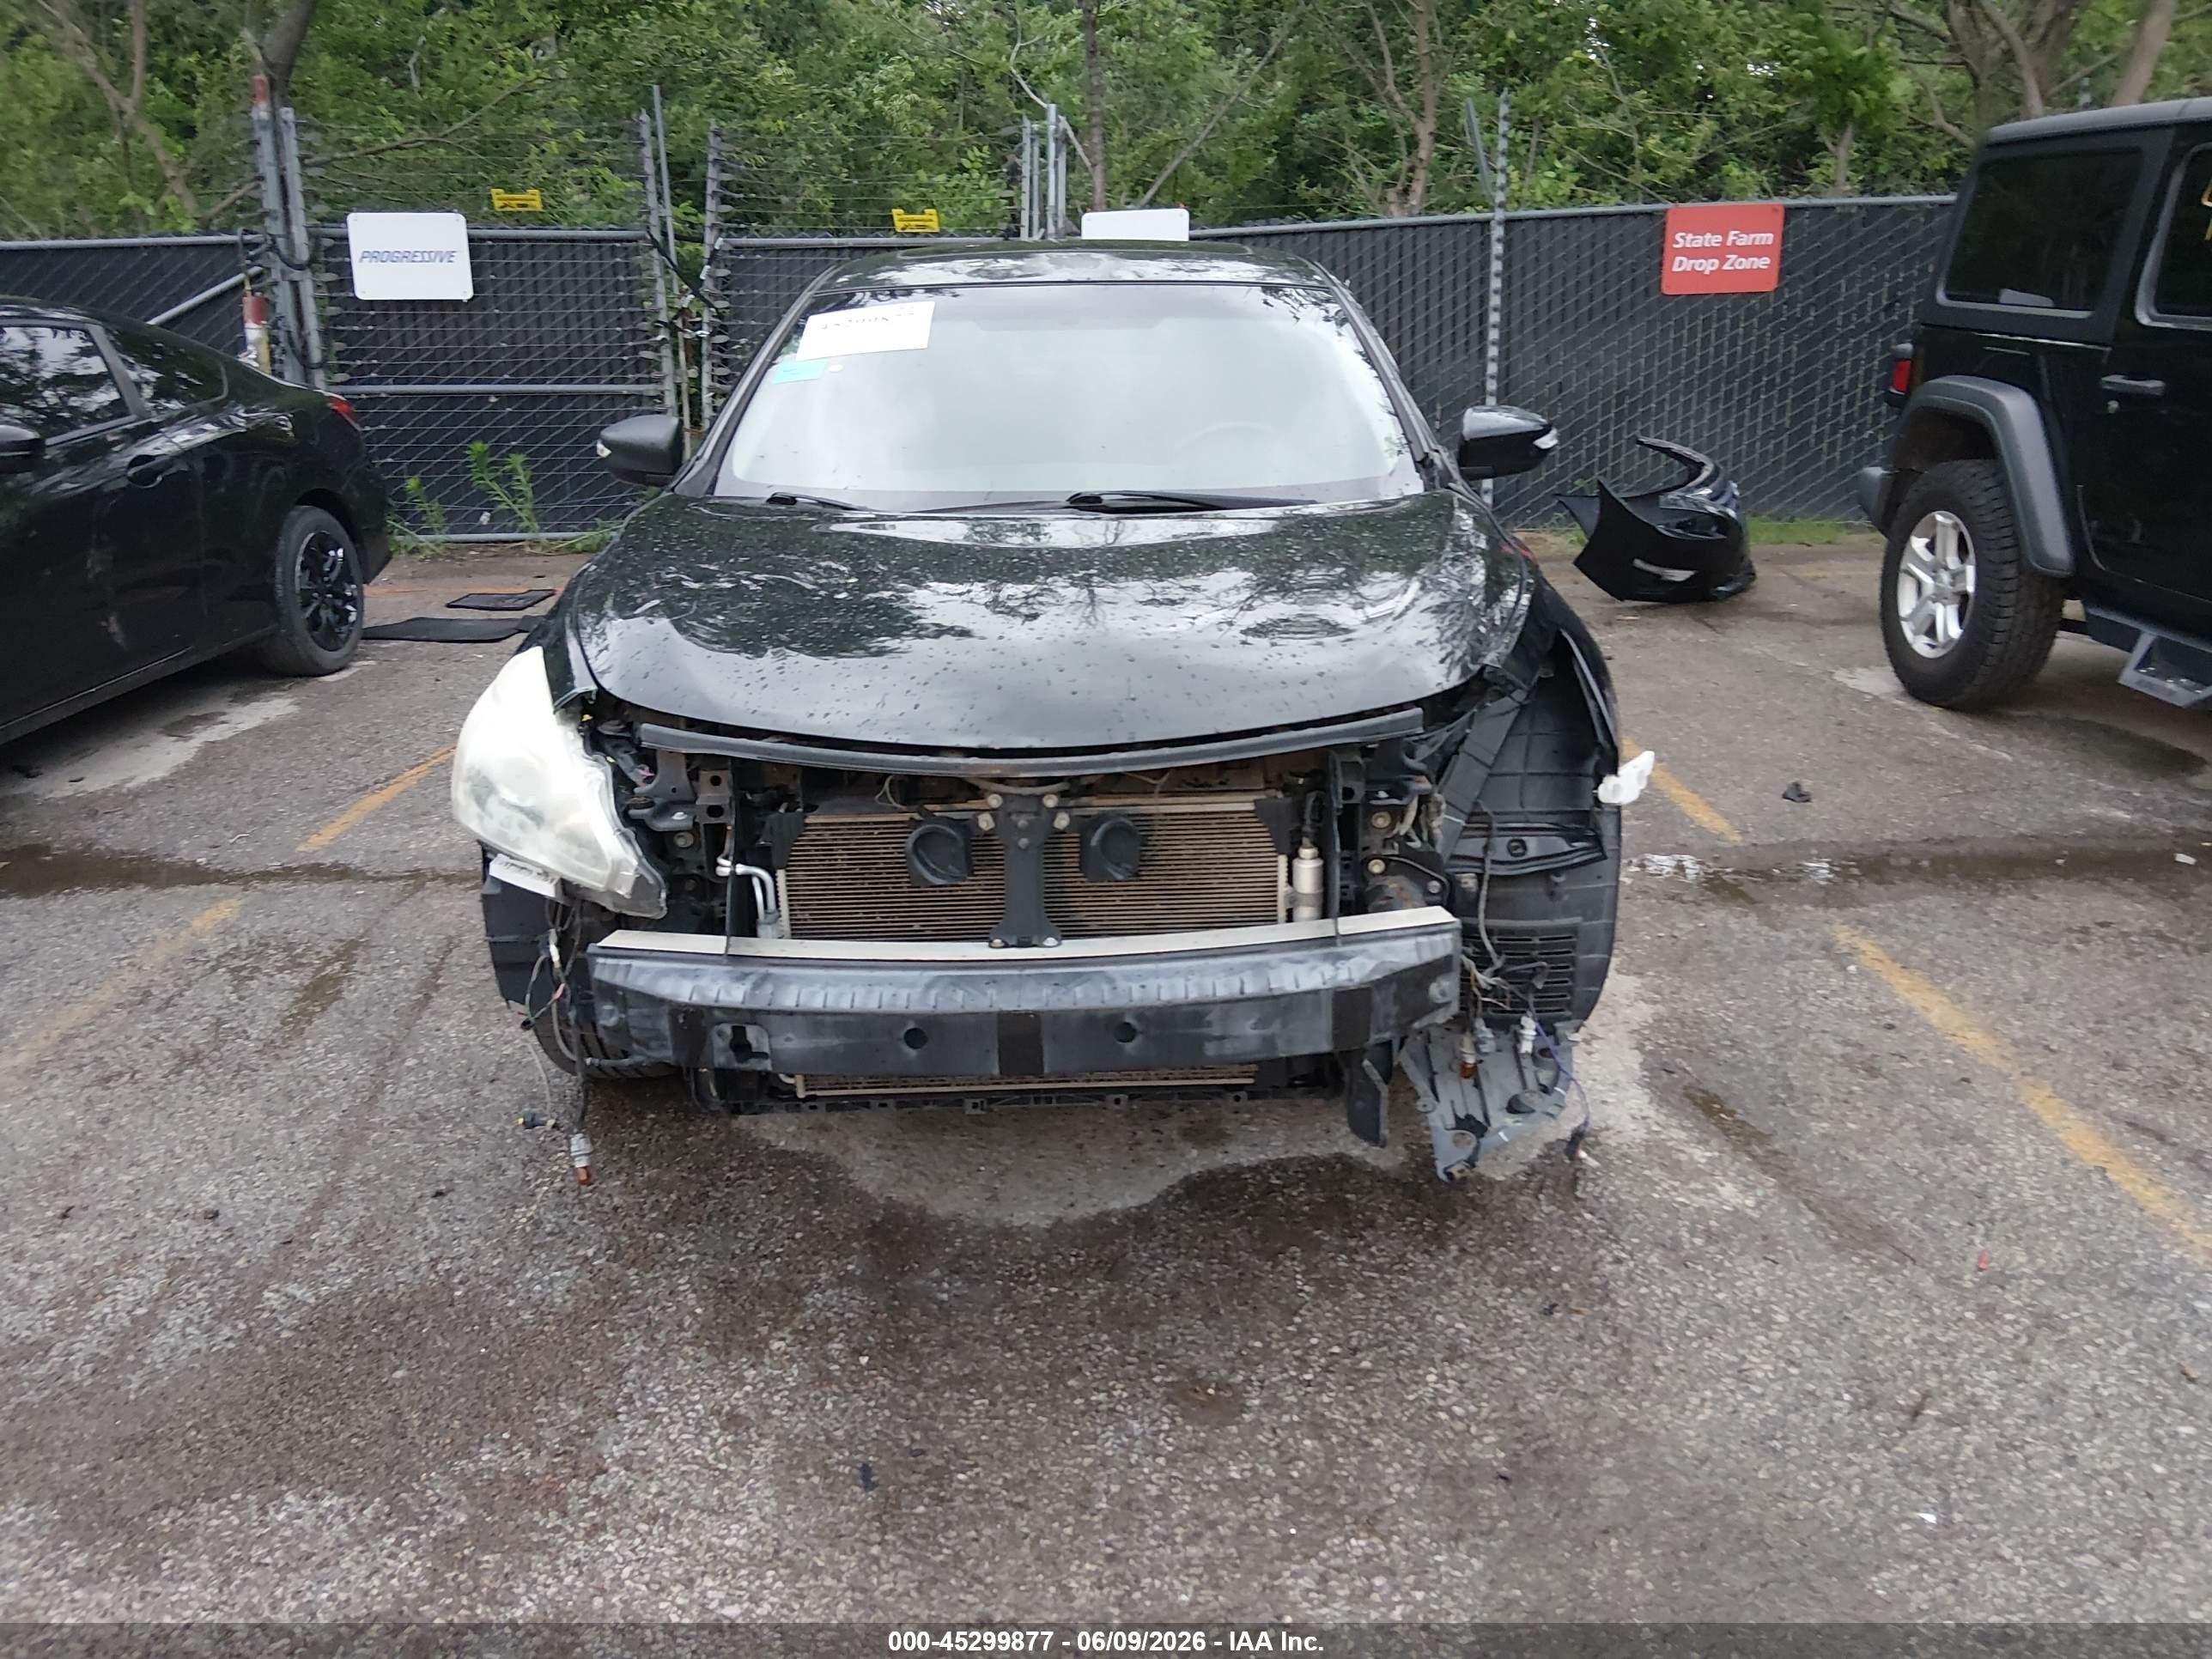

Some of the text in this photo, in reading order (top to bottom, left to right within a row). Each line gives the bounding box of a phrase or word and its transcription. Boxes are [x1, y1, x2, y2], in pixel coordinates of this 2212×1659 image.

[1672, 230, 1774, 248] State Farm
[358, 250, 458, 264] PROGRESSIVE
[1671, 254, 1771, 275] Drop Zone
